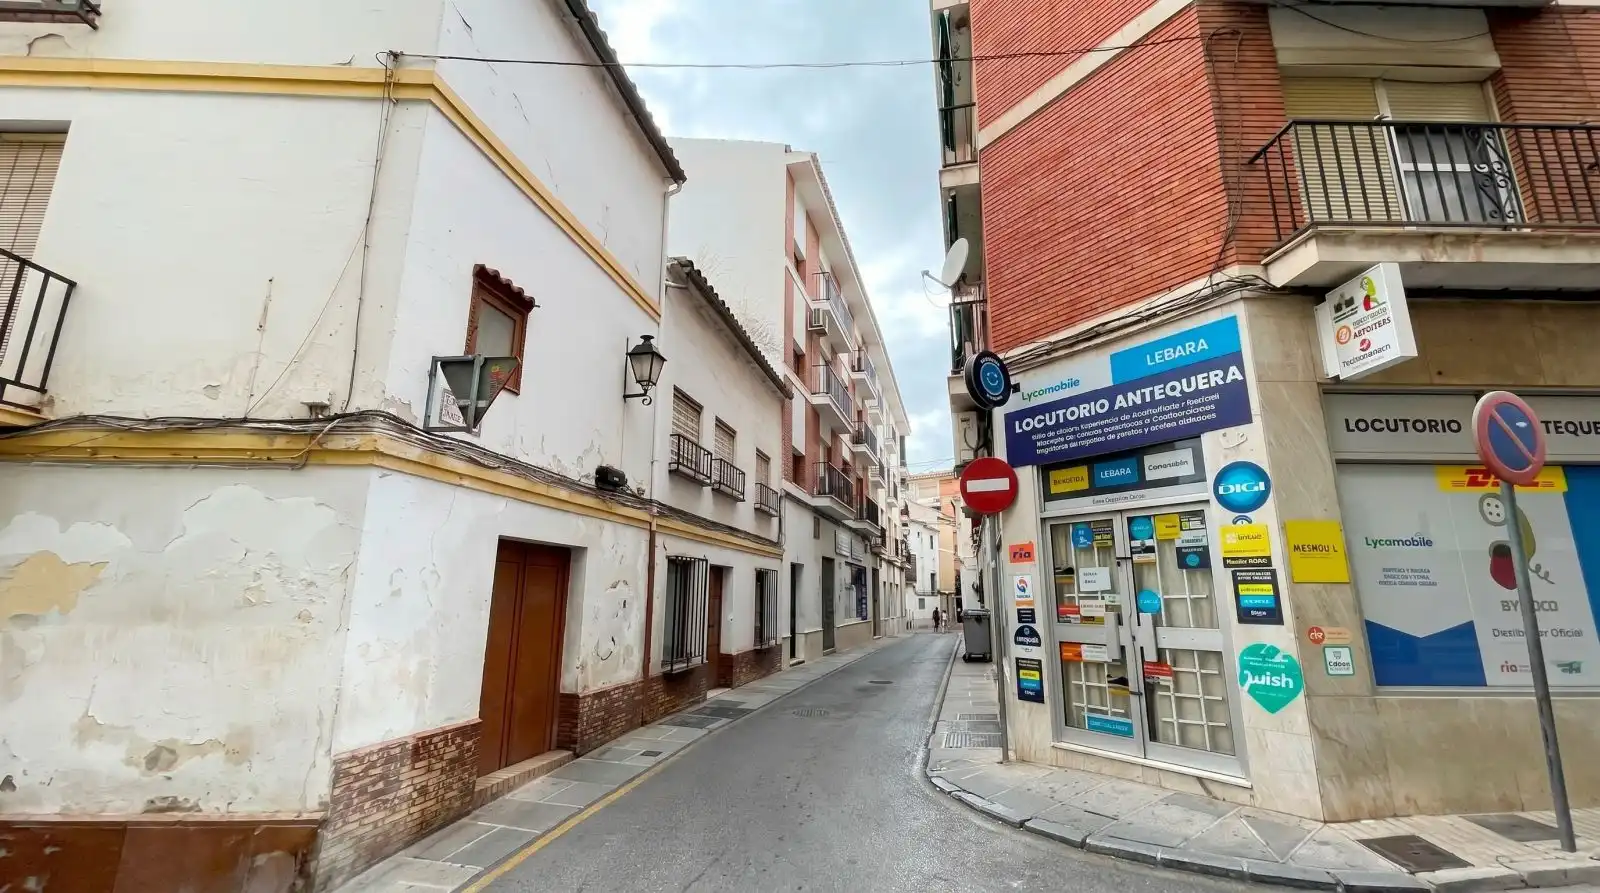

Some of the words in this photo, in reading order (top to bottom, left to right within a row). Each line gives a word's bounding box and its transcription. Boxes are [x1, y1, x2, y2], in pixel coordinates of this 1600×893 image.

[1146, 338, 1208, 366] LEBARA
[1015, 398, 1110, 434] LOCUTORIO
[1114, 364, 1244, 411] ANTEQUERA
[1121, 413, 1131, 421] de
[1345, 418, 1462, 434] LOCUTORIO
[1107, 433, 1116, 441] de
[1144, 426, 1149, 435] y
[1100, 468, 1132, 479] LEBARA
[1218, 481, 1266, 495] DIGI
[1012, 547, 1031, 559] ria
[1500, 660, 1518, 673] ria
